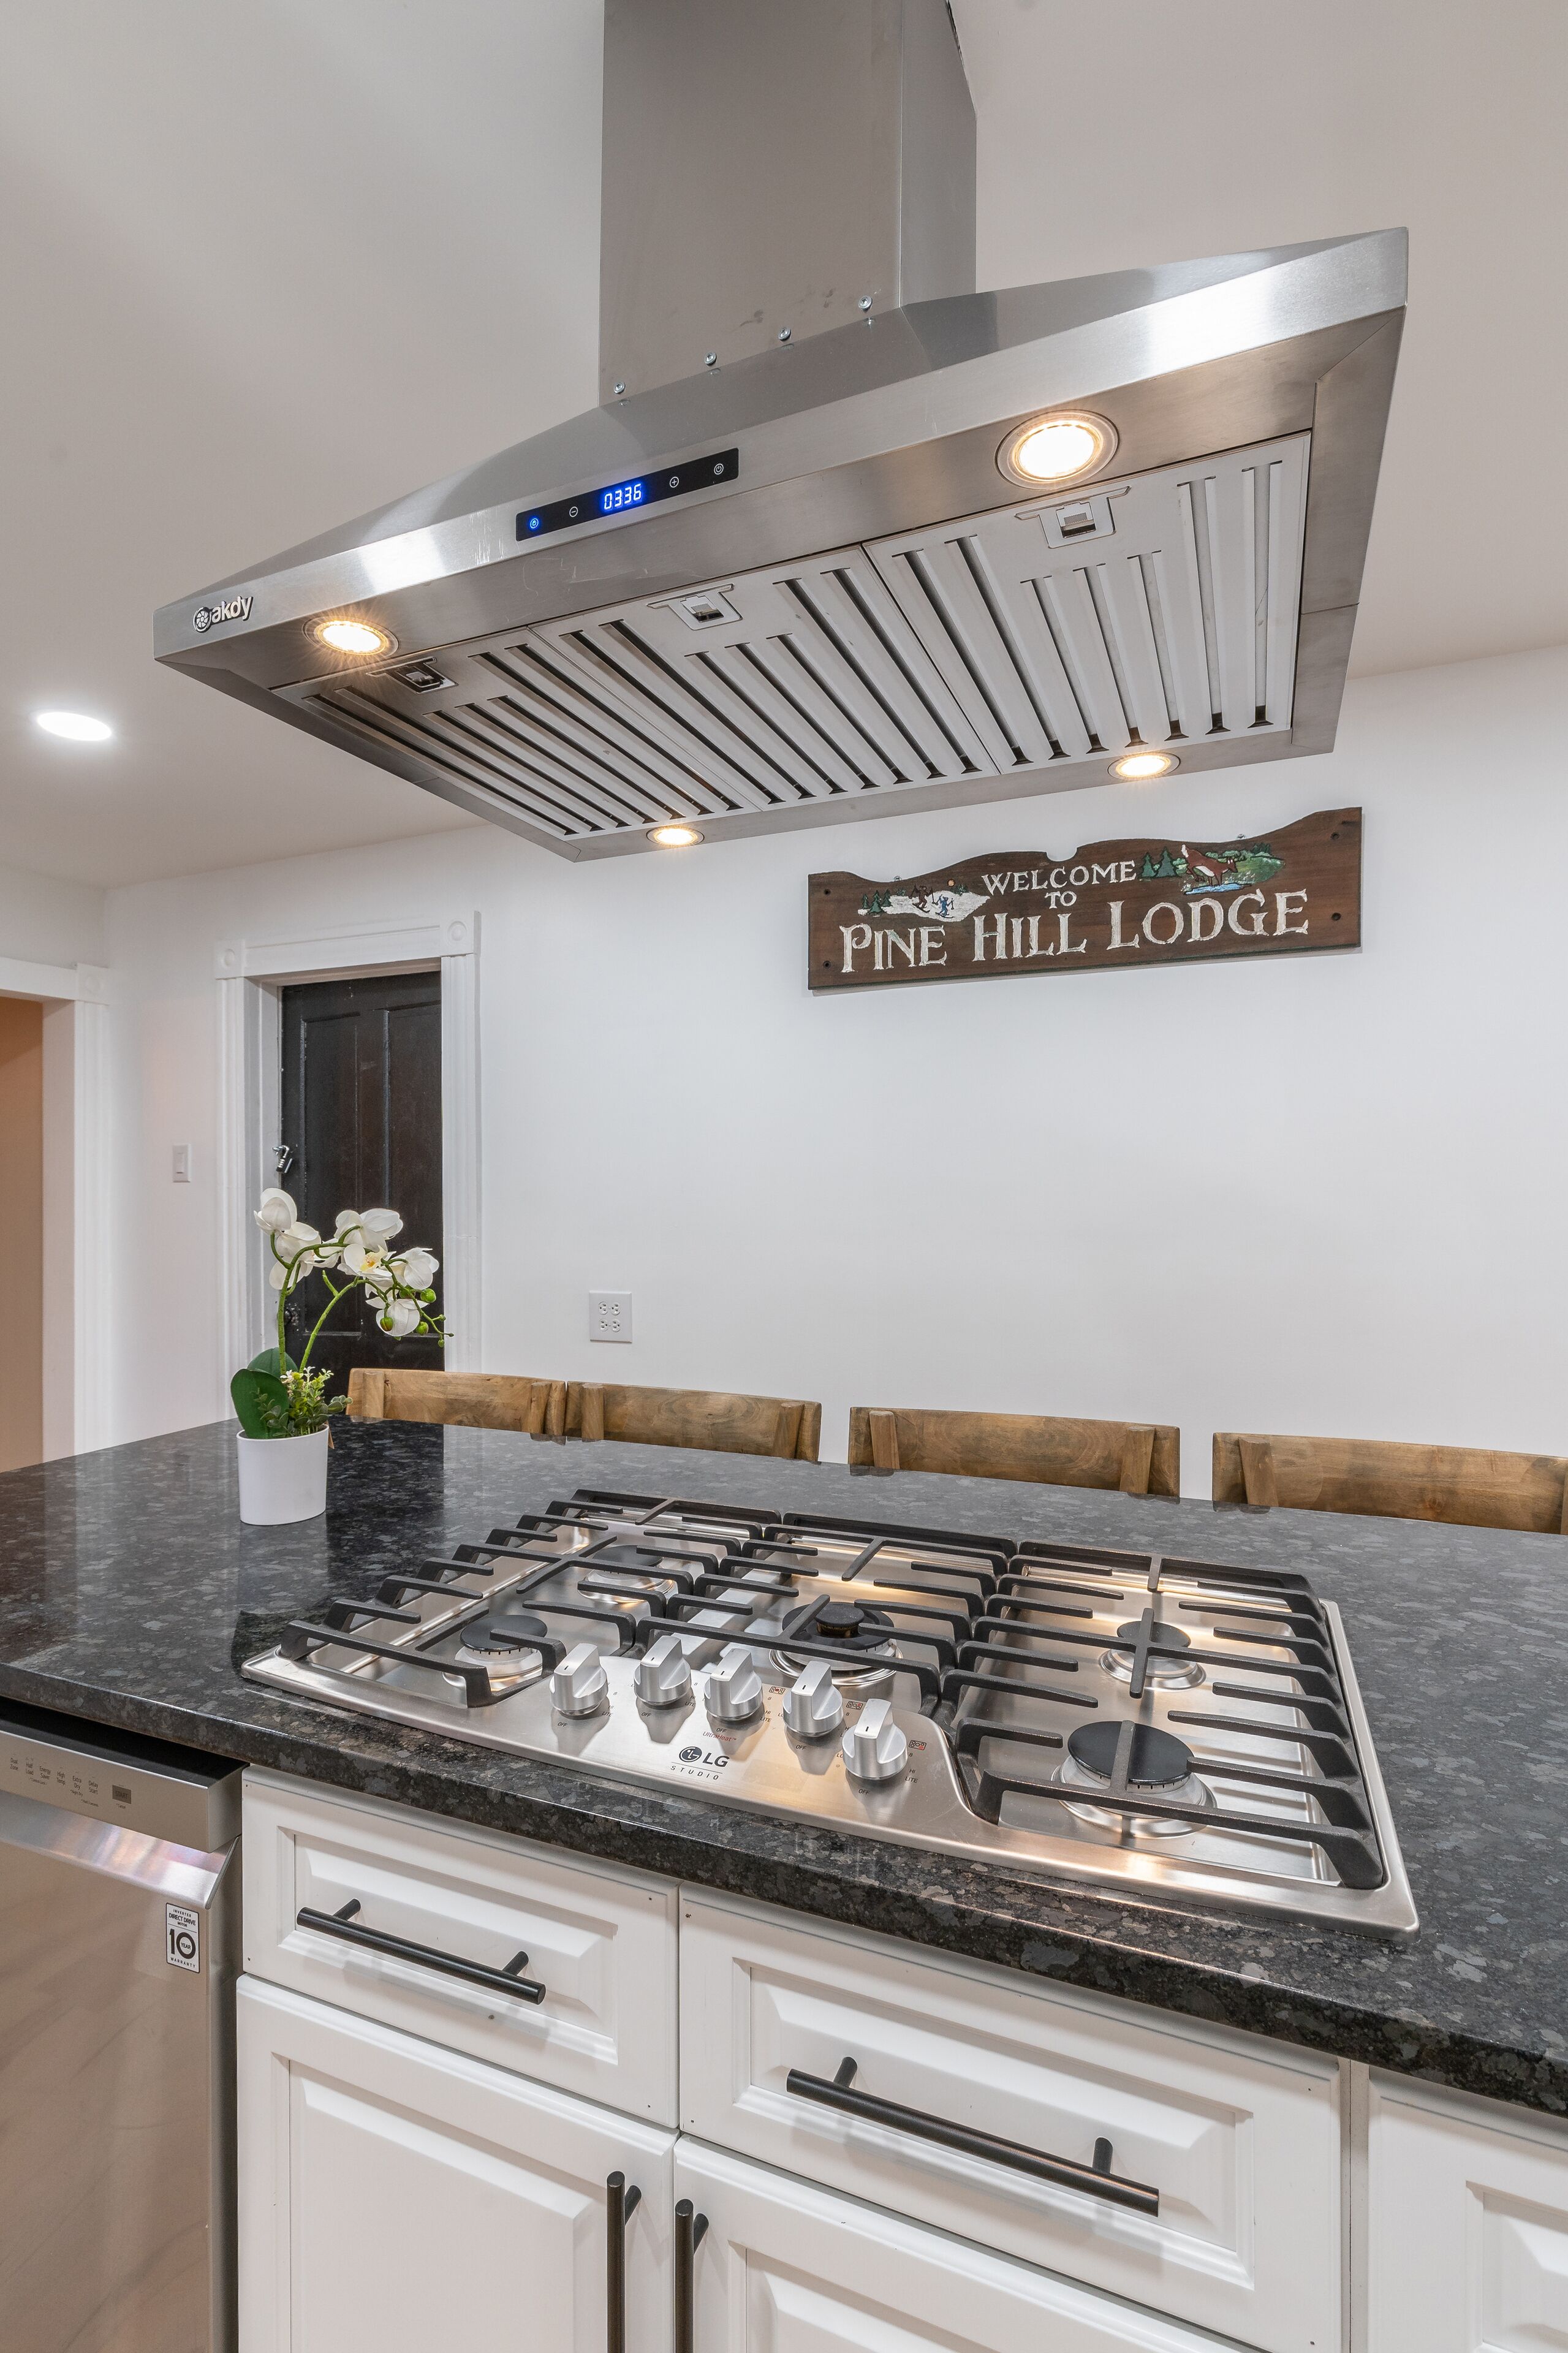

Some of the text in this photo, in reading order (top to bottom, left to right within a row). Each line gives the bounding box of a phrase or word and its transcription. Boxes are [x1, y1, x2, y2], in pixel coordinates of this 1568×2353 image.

[604, 483, 642, 510] 0336
[212, 596, 252, 621] akdy
[981, 860, 1137, 896] WELCOME
[1045, 890, 1077, 909] TO
[838, 888, 1309, 973] PINE HILL LODGE
[702, 1752, 730, 1767] LG
[39, 1765, 51, 1775] Energy
[670, 1765, 719, 1780] STUDIO
[56, 1777, 66, 1786] Temp
[88, 1780, 98, 1789] Delay
[115, 1790, 128, 1799] START
[169, 1912, 196, 1926] DIRECT DRIVE
[173, 1909, 191, 1917] INVERTER
[169, 1928, 196, 1960] 10
[170, 1957, 195, 1968] WARRANTY
